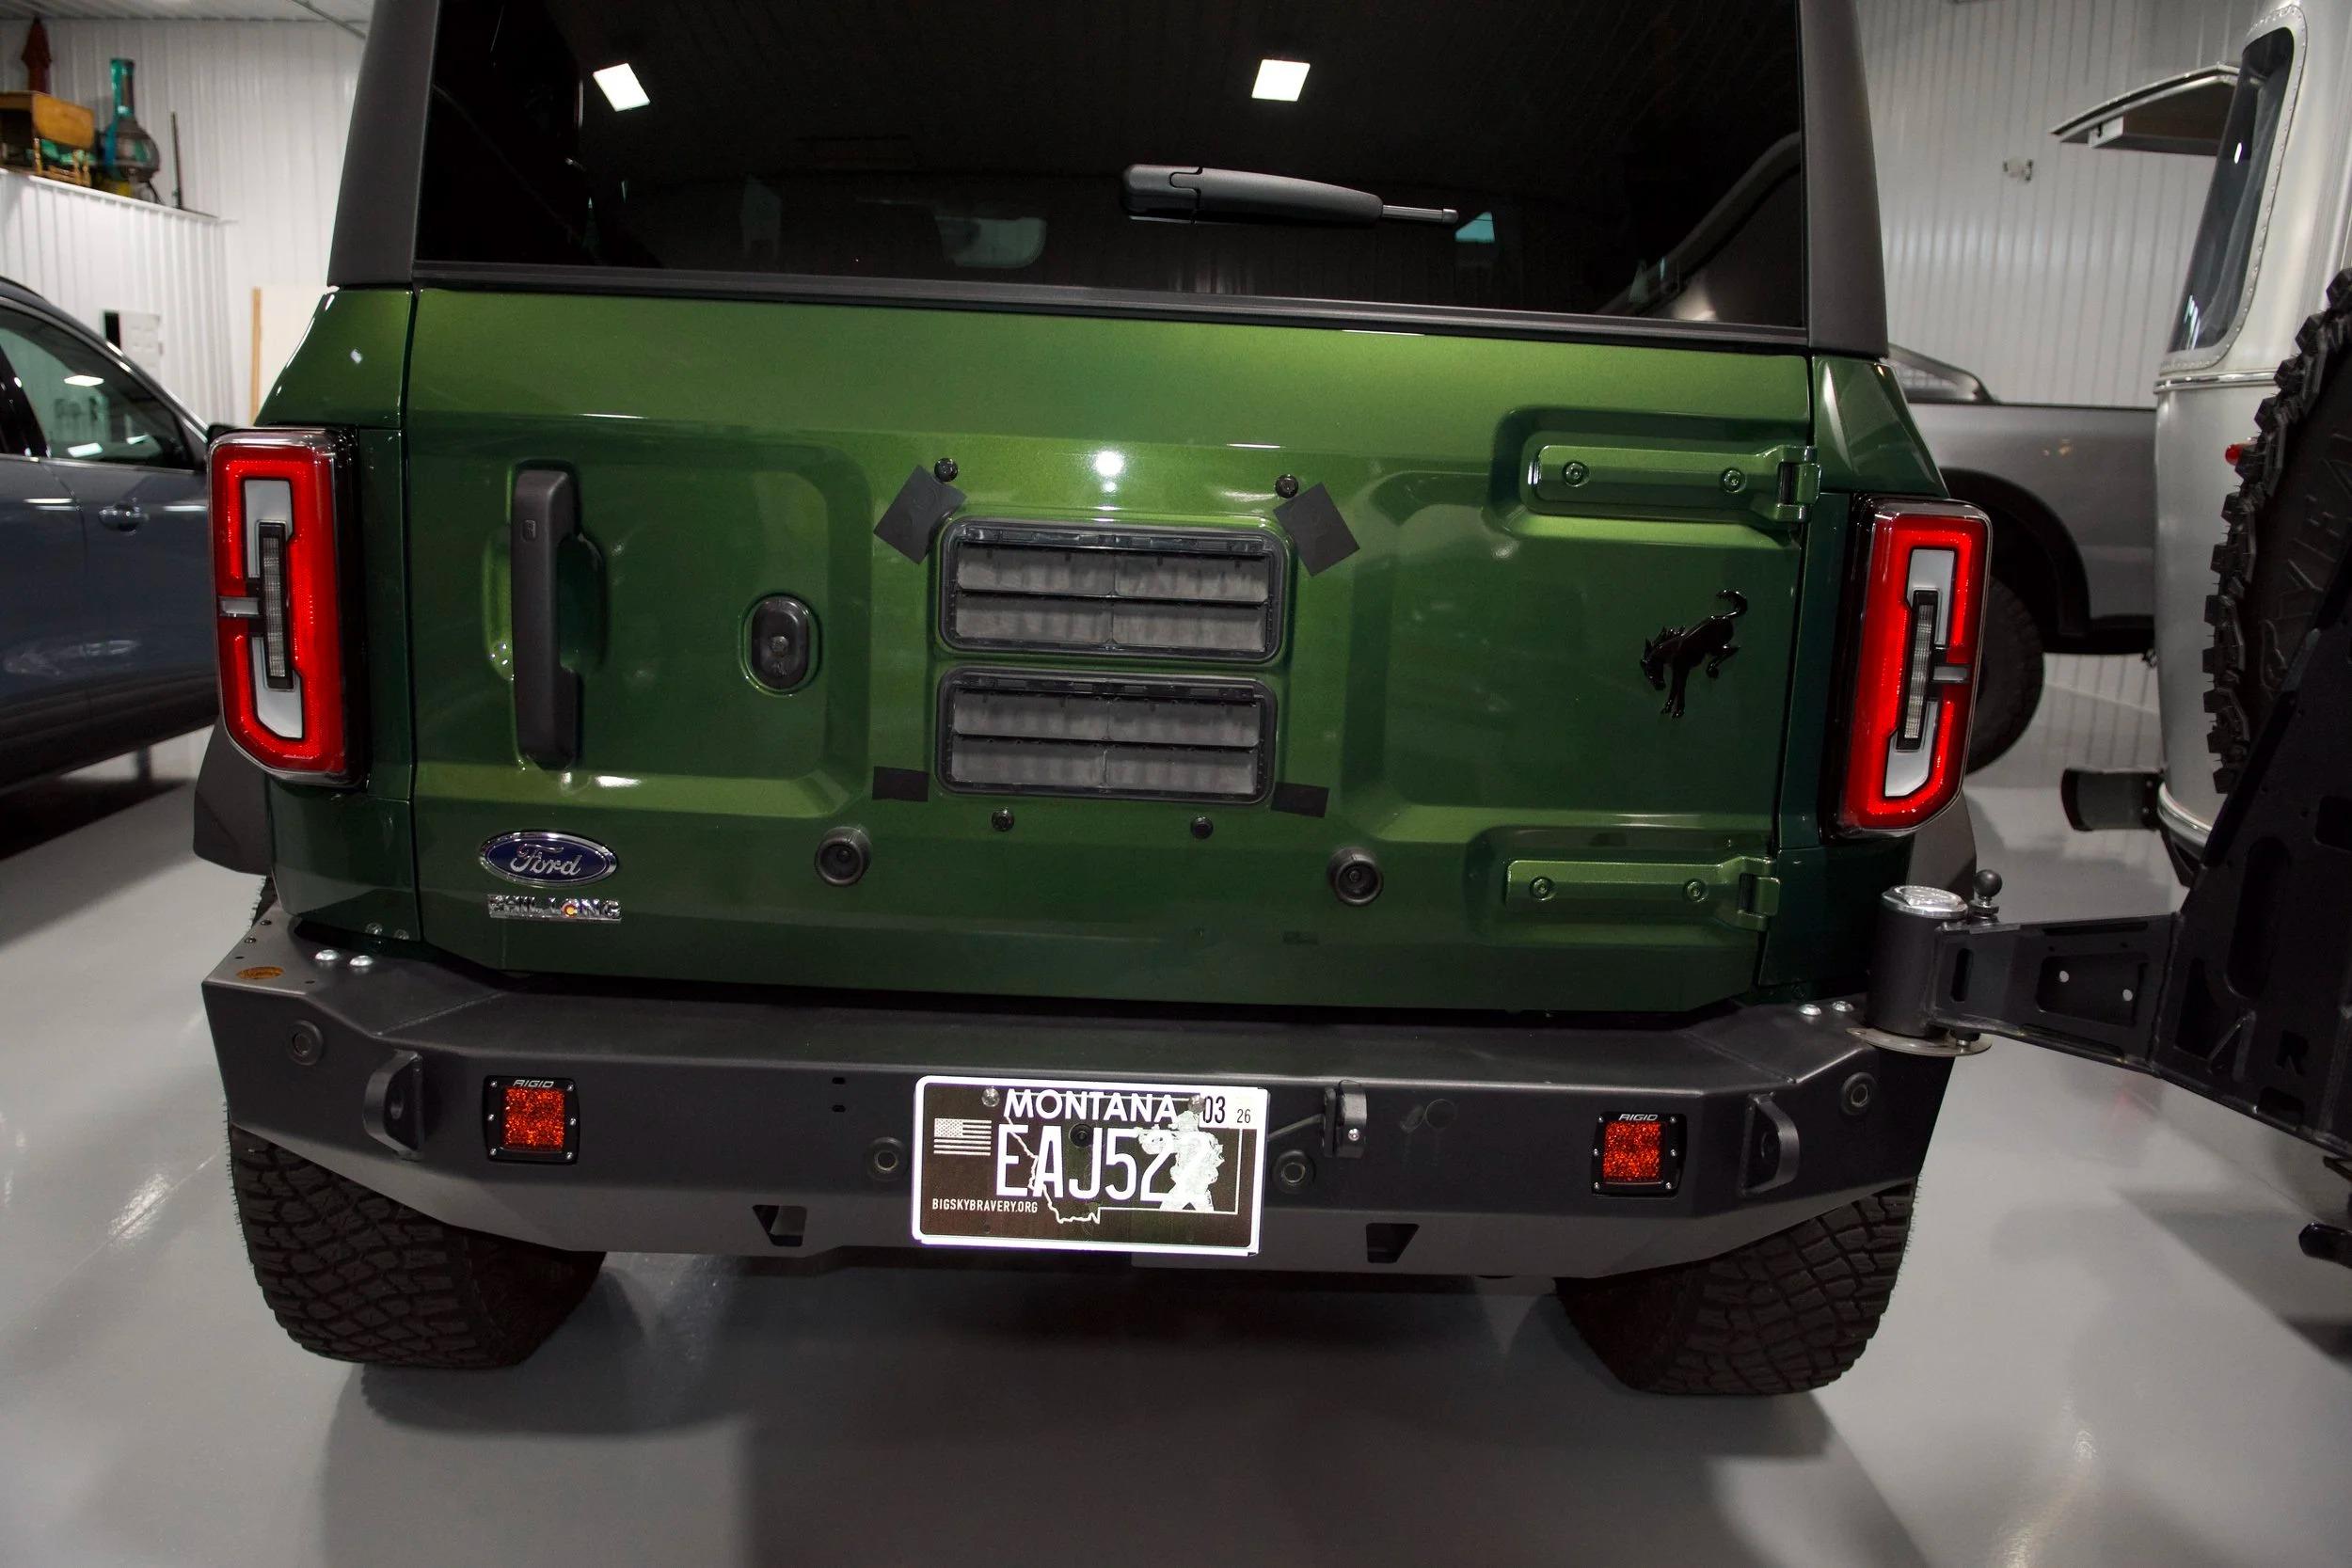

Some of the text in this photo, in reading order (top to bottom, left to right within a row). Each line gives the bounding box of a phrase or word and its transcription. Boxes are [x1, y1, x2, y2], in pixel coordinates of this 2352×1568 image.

[509, 843, 583, 876] Ford
[513, 1079, 554, 1088] RIGID
[1003, 1088, 1179, 1123] MONTANA
[1202, 1095, 1251, 1124] 03 26
[931, 1197, 1038, 1213] BIGSKYBRAVERY.ORG
